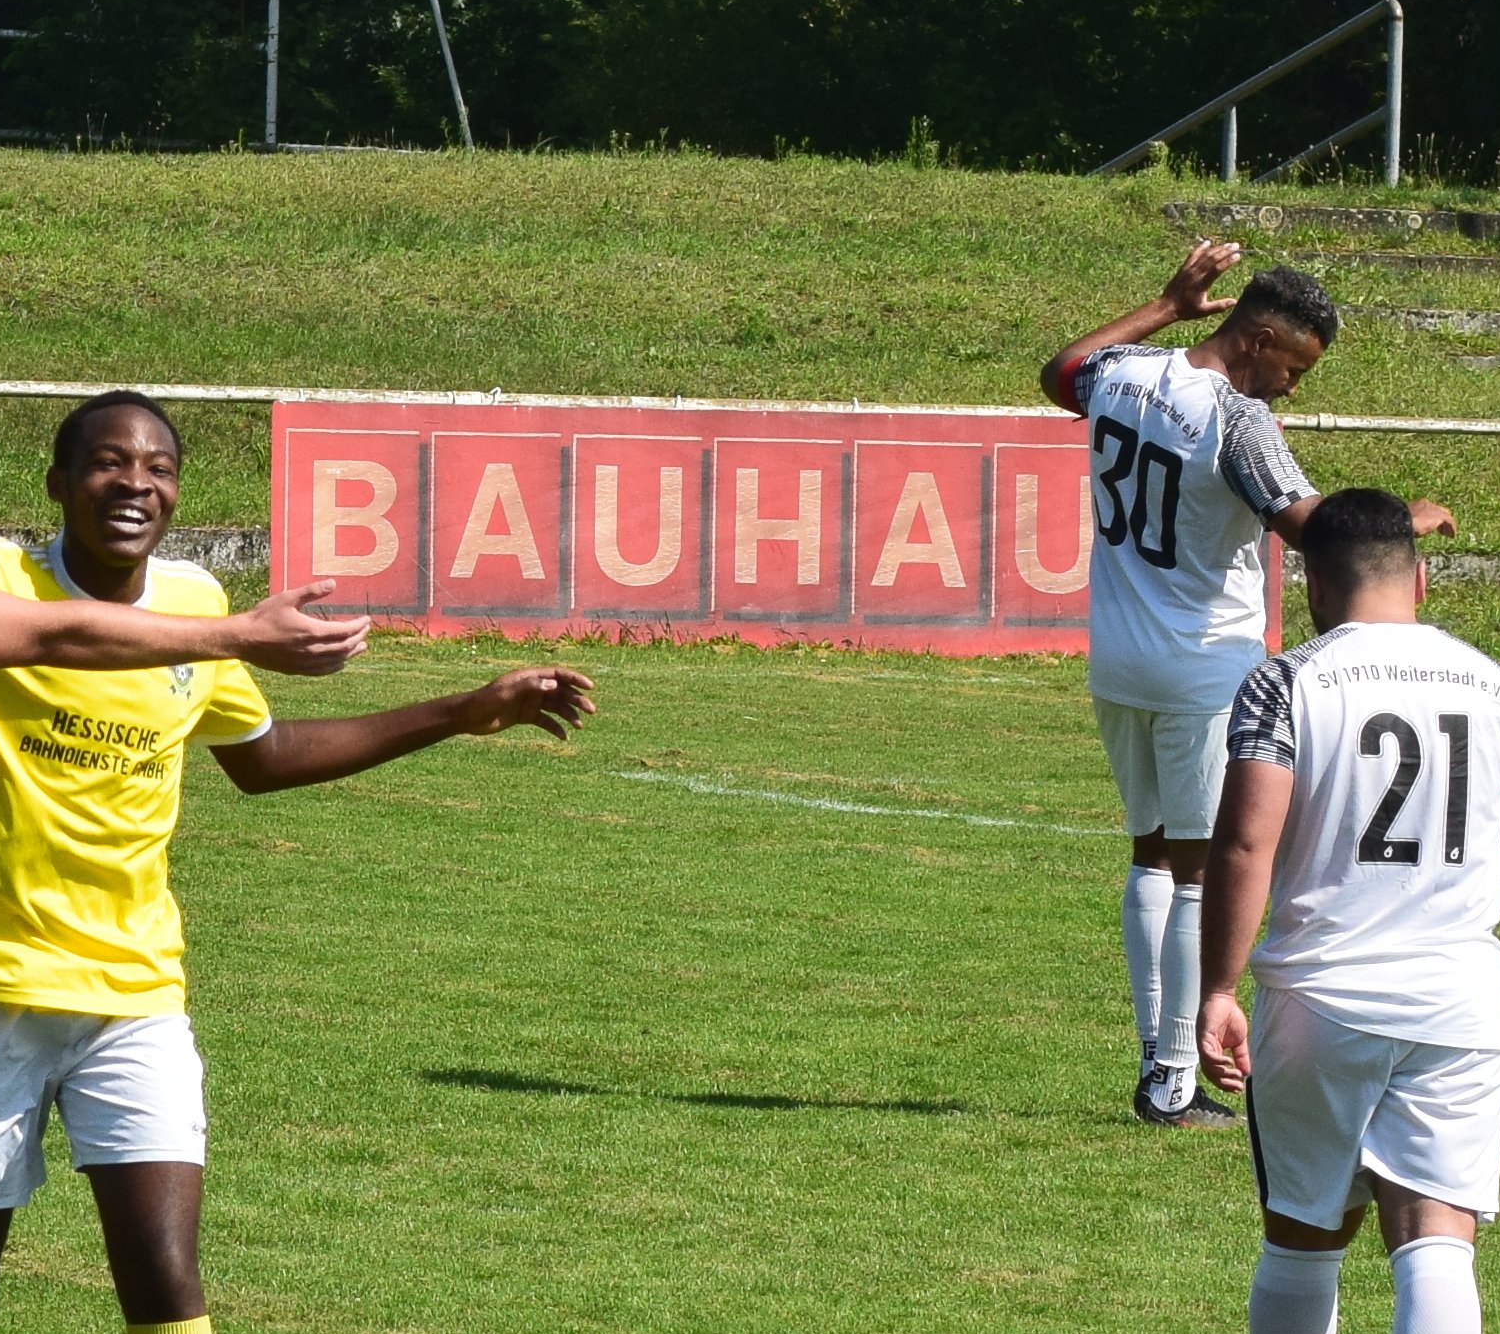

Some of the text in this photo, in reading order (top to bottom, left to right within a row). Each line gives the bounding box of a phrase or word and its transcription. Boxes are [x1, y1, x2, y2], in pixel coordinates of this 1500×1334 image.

[311, 460, 1090, 594] BAUHAU
[1093, 414, 1183, 570] 30
[1317, 670, 1339, 689] SV
[1343, 664, 1381, 683] 1910
[1384, 664, 1476, 688] Weiterstadt
[19, 734, 131, 776] BAHNDIENSTE
[51, 709, 161, 754] HESSISCHE
[1356, 710, 1471, 866] 21
